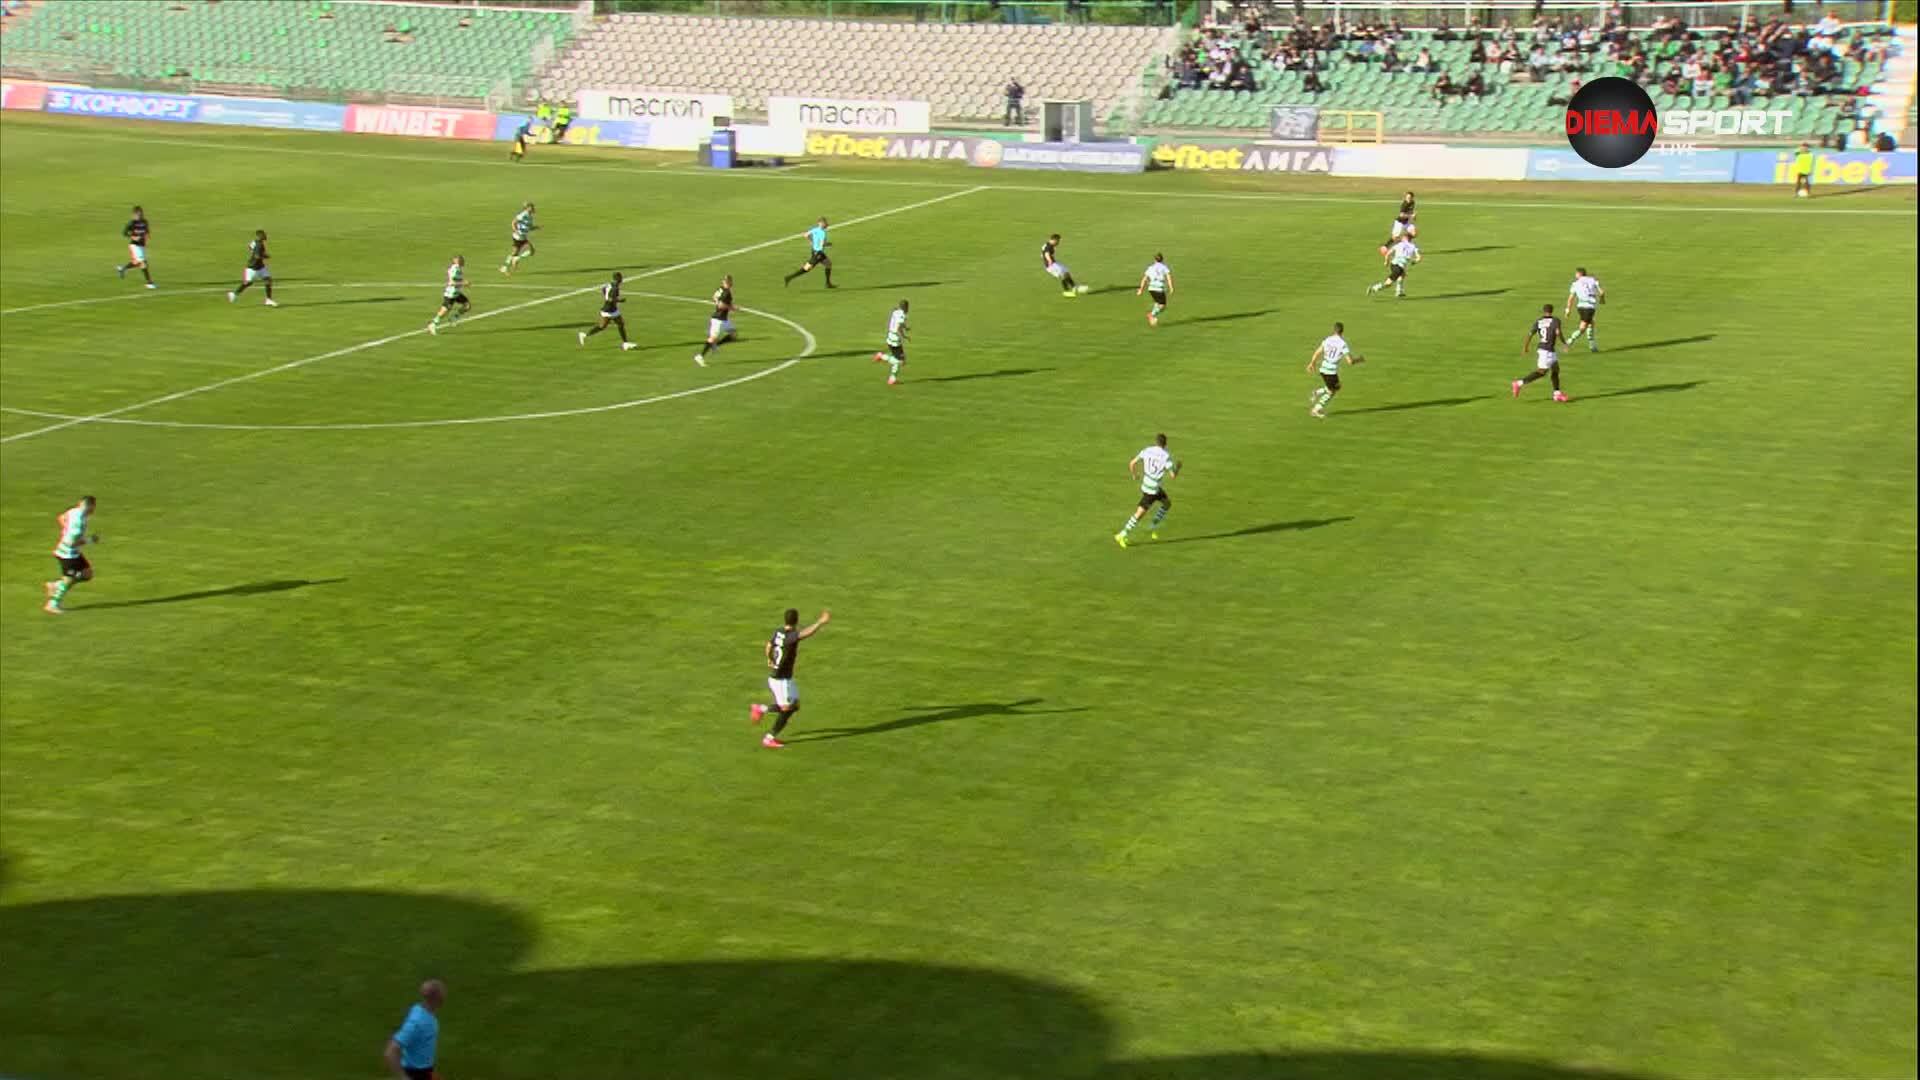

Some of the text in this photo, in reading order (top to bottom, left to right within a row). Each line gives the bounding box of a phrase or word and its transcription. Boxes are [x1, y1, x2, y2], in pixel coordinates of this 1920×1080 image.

[608, 96, 703, 118] macron
[799, 103, 897, 126] macron
[353, 107, 463, 138] WINBET
[806, 132, 888, 159] efbet
